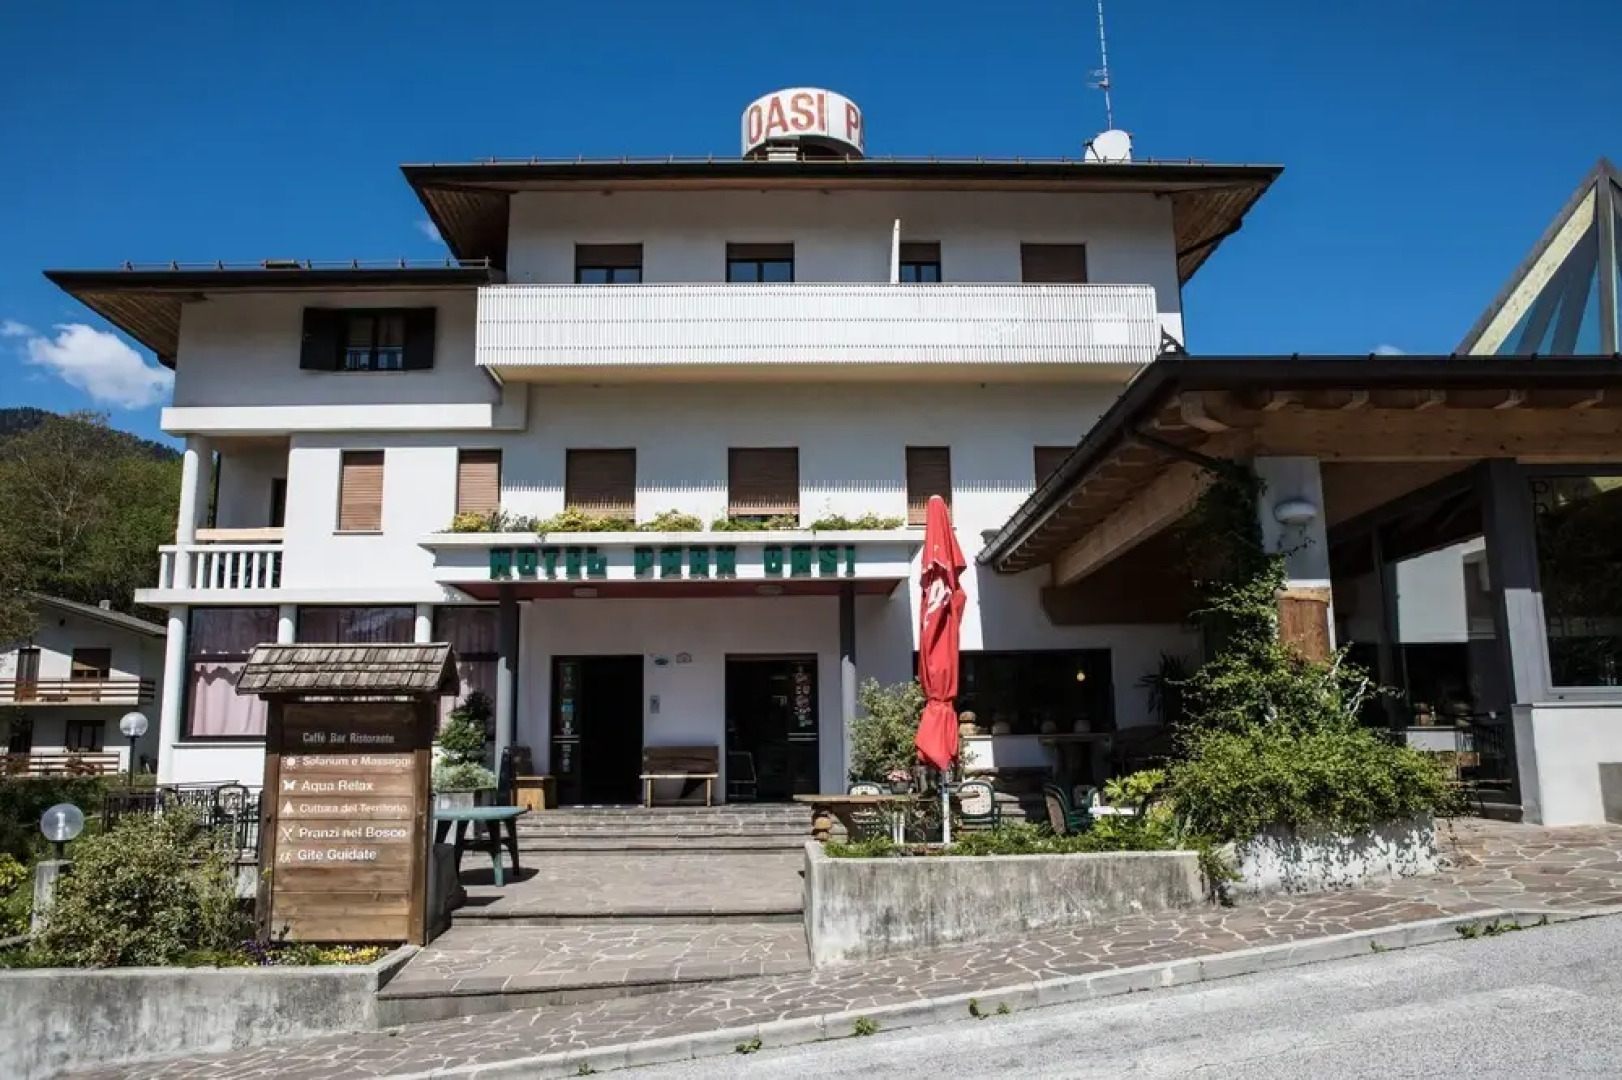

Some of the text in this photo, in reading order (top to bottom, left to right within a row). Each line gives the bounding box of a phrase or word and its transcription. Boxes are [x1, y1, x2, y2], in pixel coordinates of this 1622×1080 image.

[748, 92, 825, 145] OASI
[490, 545, 855, 578] HOTEL PARK OASI
[330, 732, 347, 743] Bar
[349, 732, 395, 744] Ristorante
[302, 756, 349, 766] Solarium
[360, 756, 412, 768] Massaggi
[301, 779, 374, 792] Aqua Relax
[340, 803, 358, 813] del
[359, 803, 408, 813] Territorio
[299, 826, 407, 838] Pranzi nel Bosco
[297, 849, 378, 861] Gite Guidate
